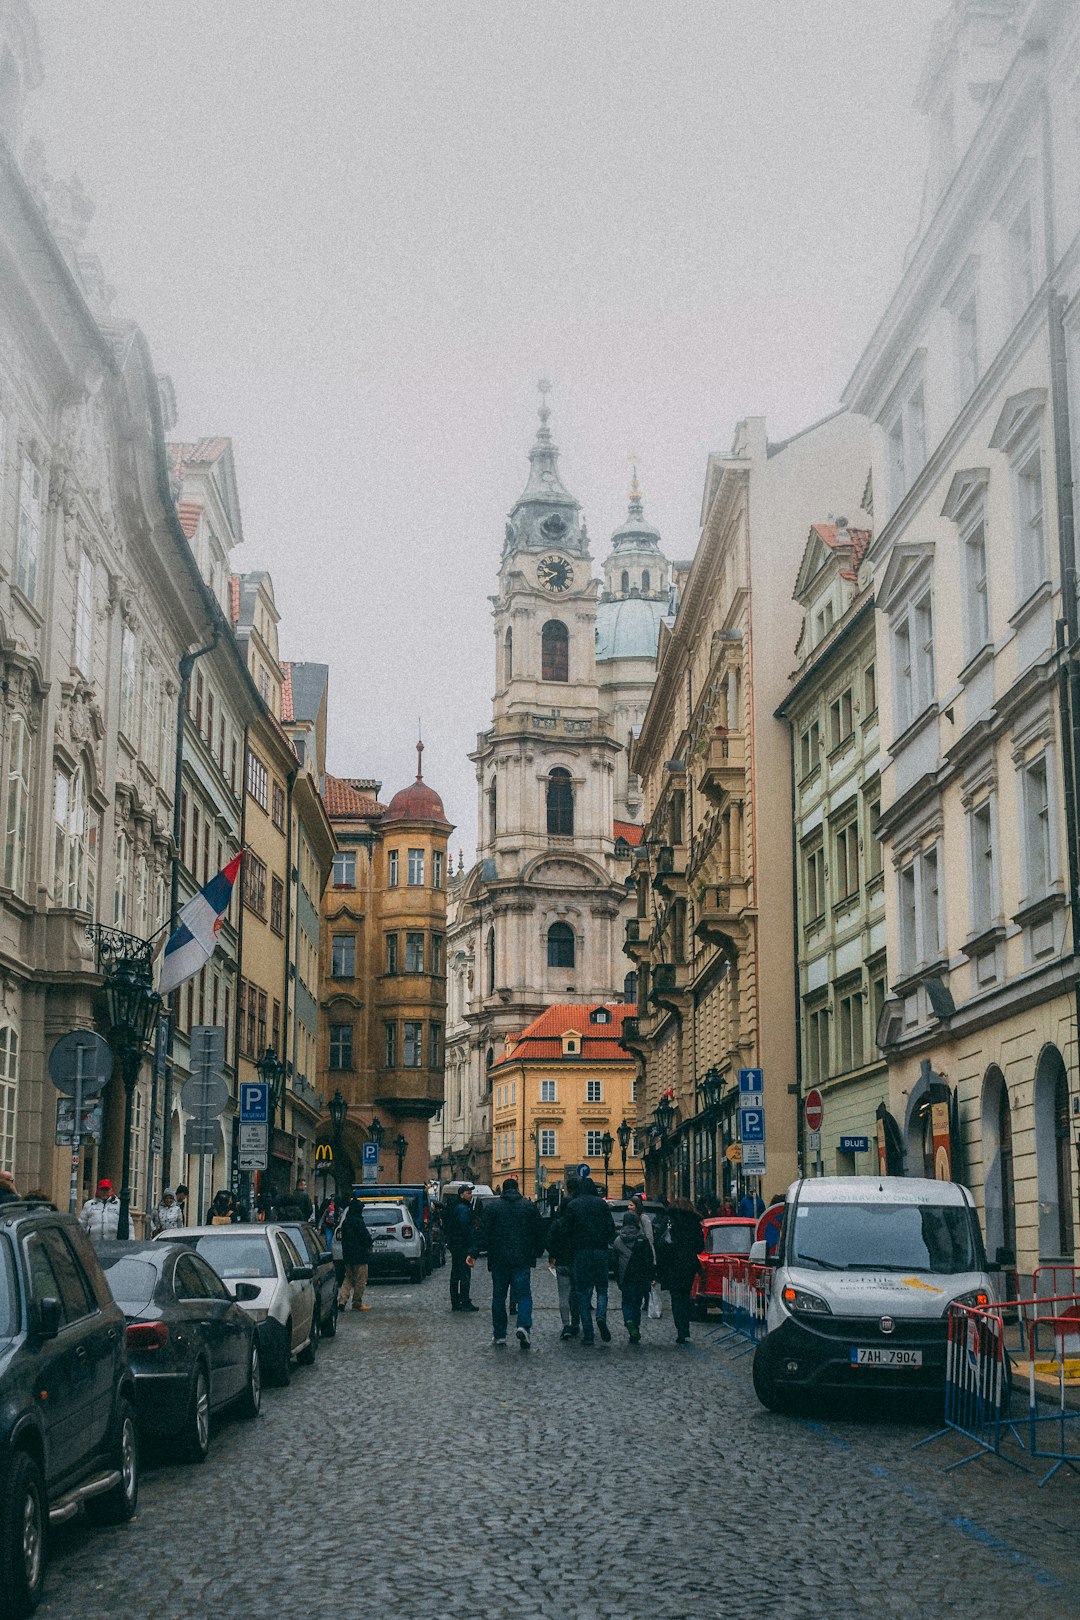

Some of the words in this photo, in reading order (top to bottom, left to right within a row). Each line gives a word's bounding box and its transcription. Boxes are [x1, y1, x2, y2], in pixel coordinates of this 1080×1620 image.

[246, 1088, 262, 1110] P
[745, 1112, 760, 1132] P
[844, 1139, 865, 1147] BLUE
[366, 1145, 376, 1159] P
[860, 1350, 881, 1362] 7AH
[889, 1351, 917, 1363] 7904
